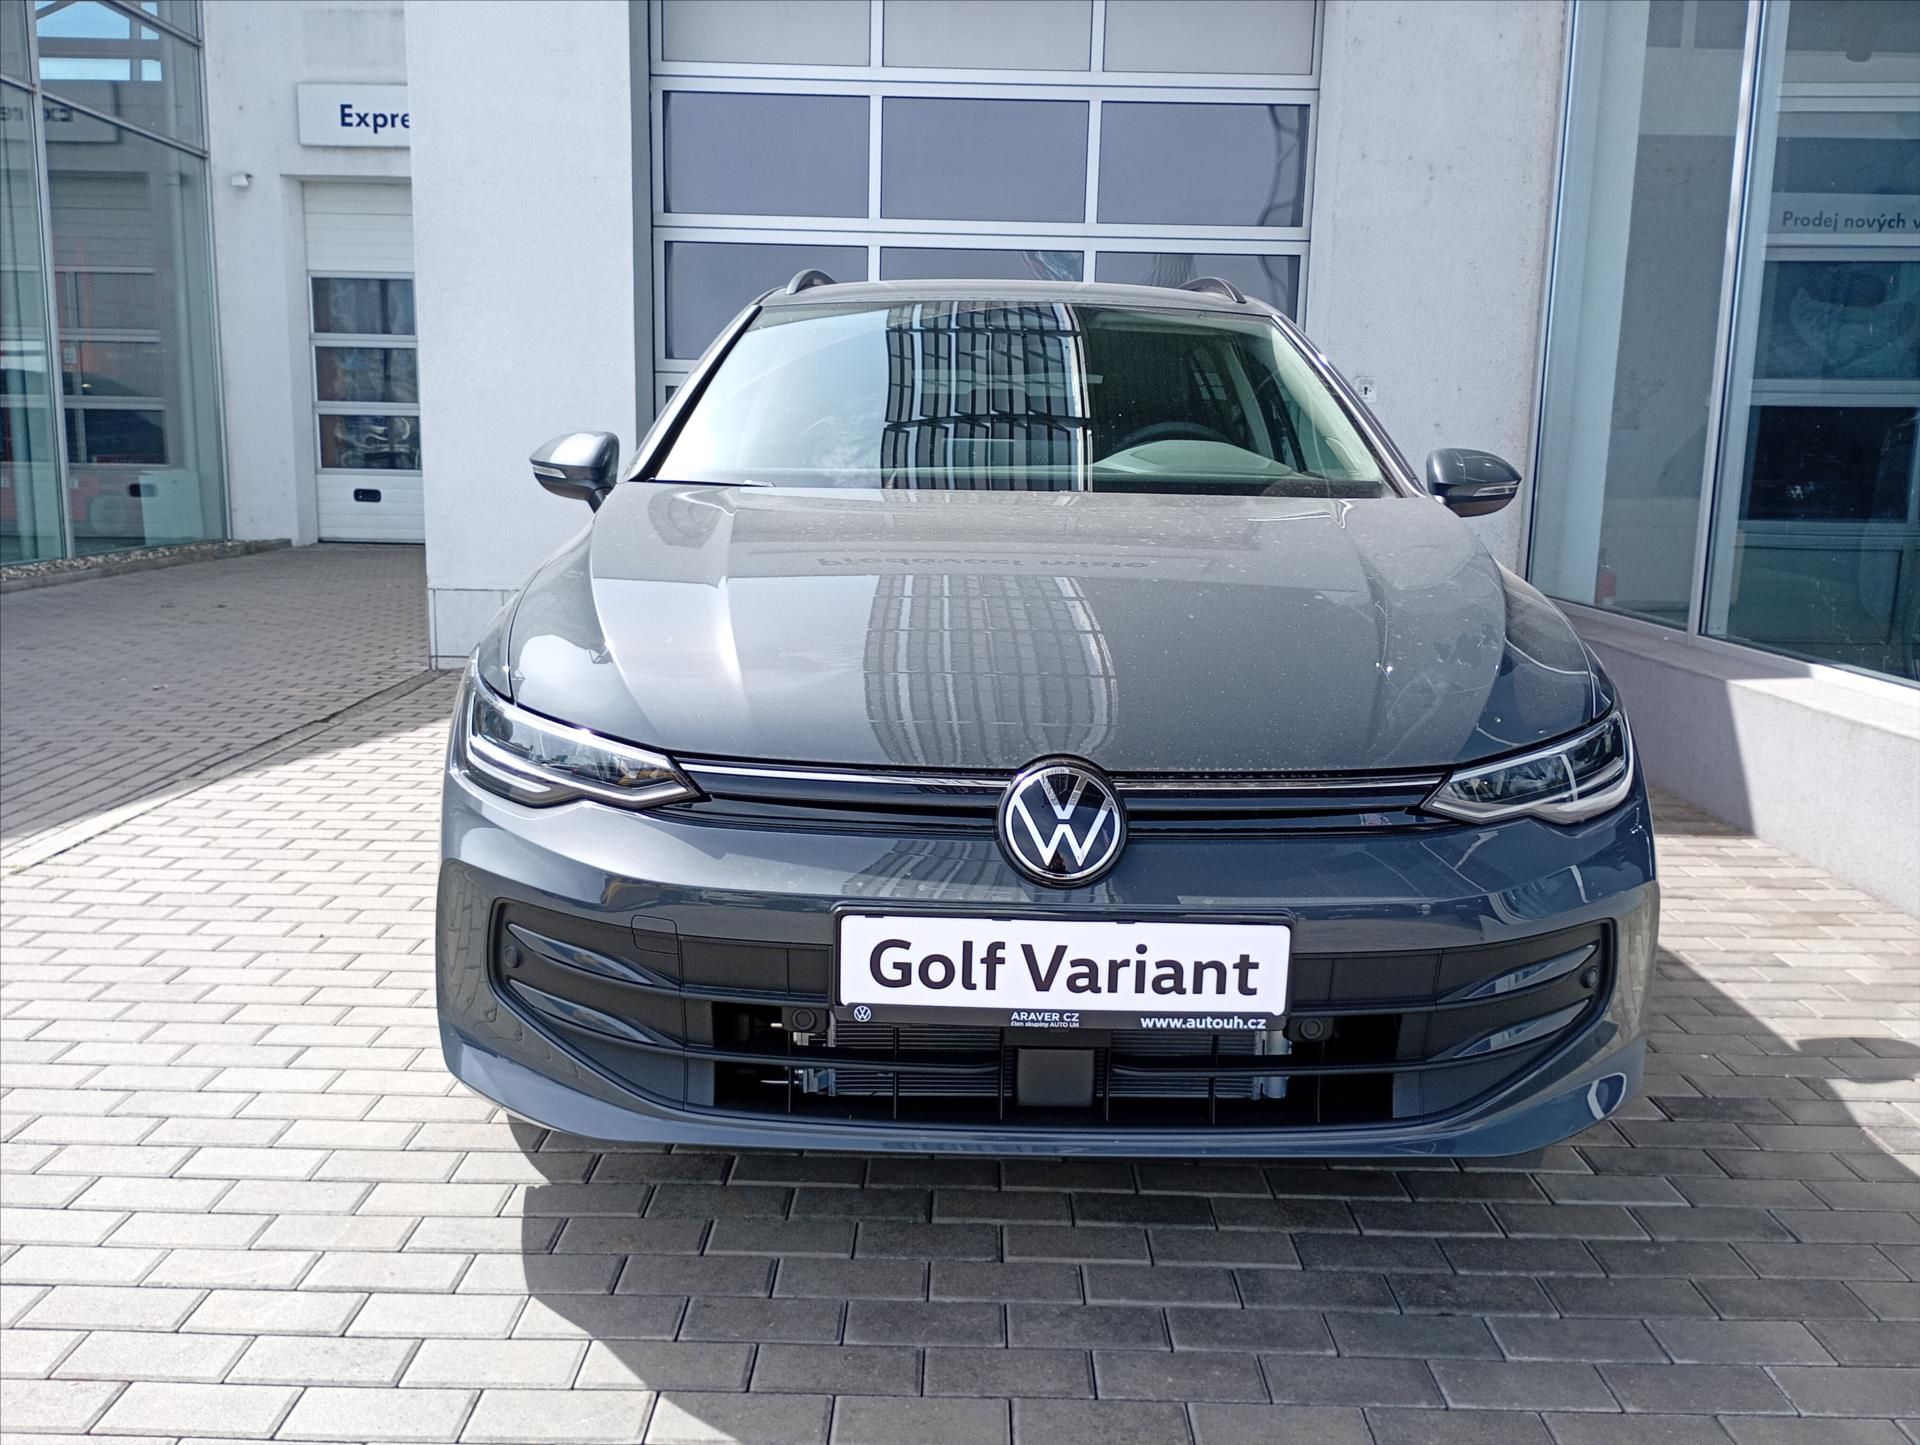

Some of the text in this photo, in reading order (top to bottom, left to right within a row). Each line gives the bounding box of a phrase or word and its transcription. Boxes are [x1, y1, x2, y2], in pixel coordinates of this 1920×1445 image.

[340, 103, 410, 134] Expre
[1782, 210, 1839, 232] Prodej
[1844, 212, 1906, 232] nových
[1008, 768, 1117, 875] VW
[869, 938, 1260, 996] Golf Variant
[854, 1005, 872, 1022] VW
[1010, 1011, 1080, 1022] ARAVER CZ
[1140, 1015, 1267, 1030] www.autouh.cz
